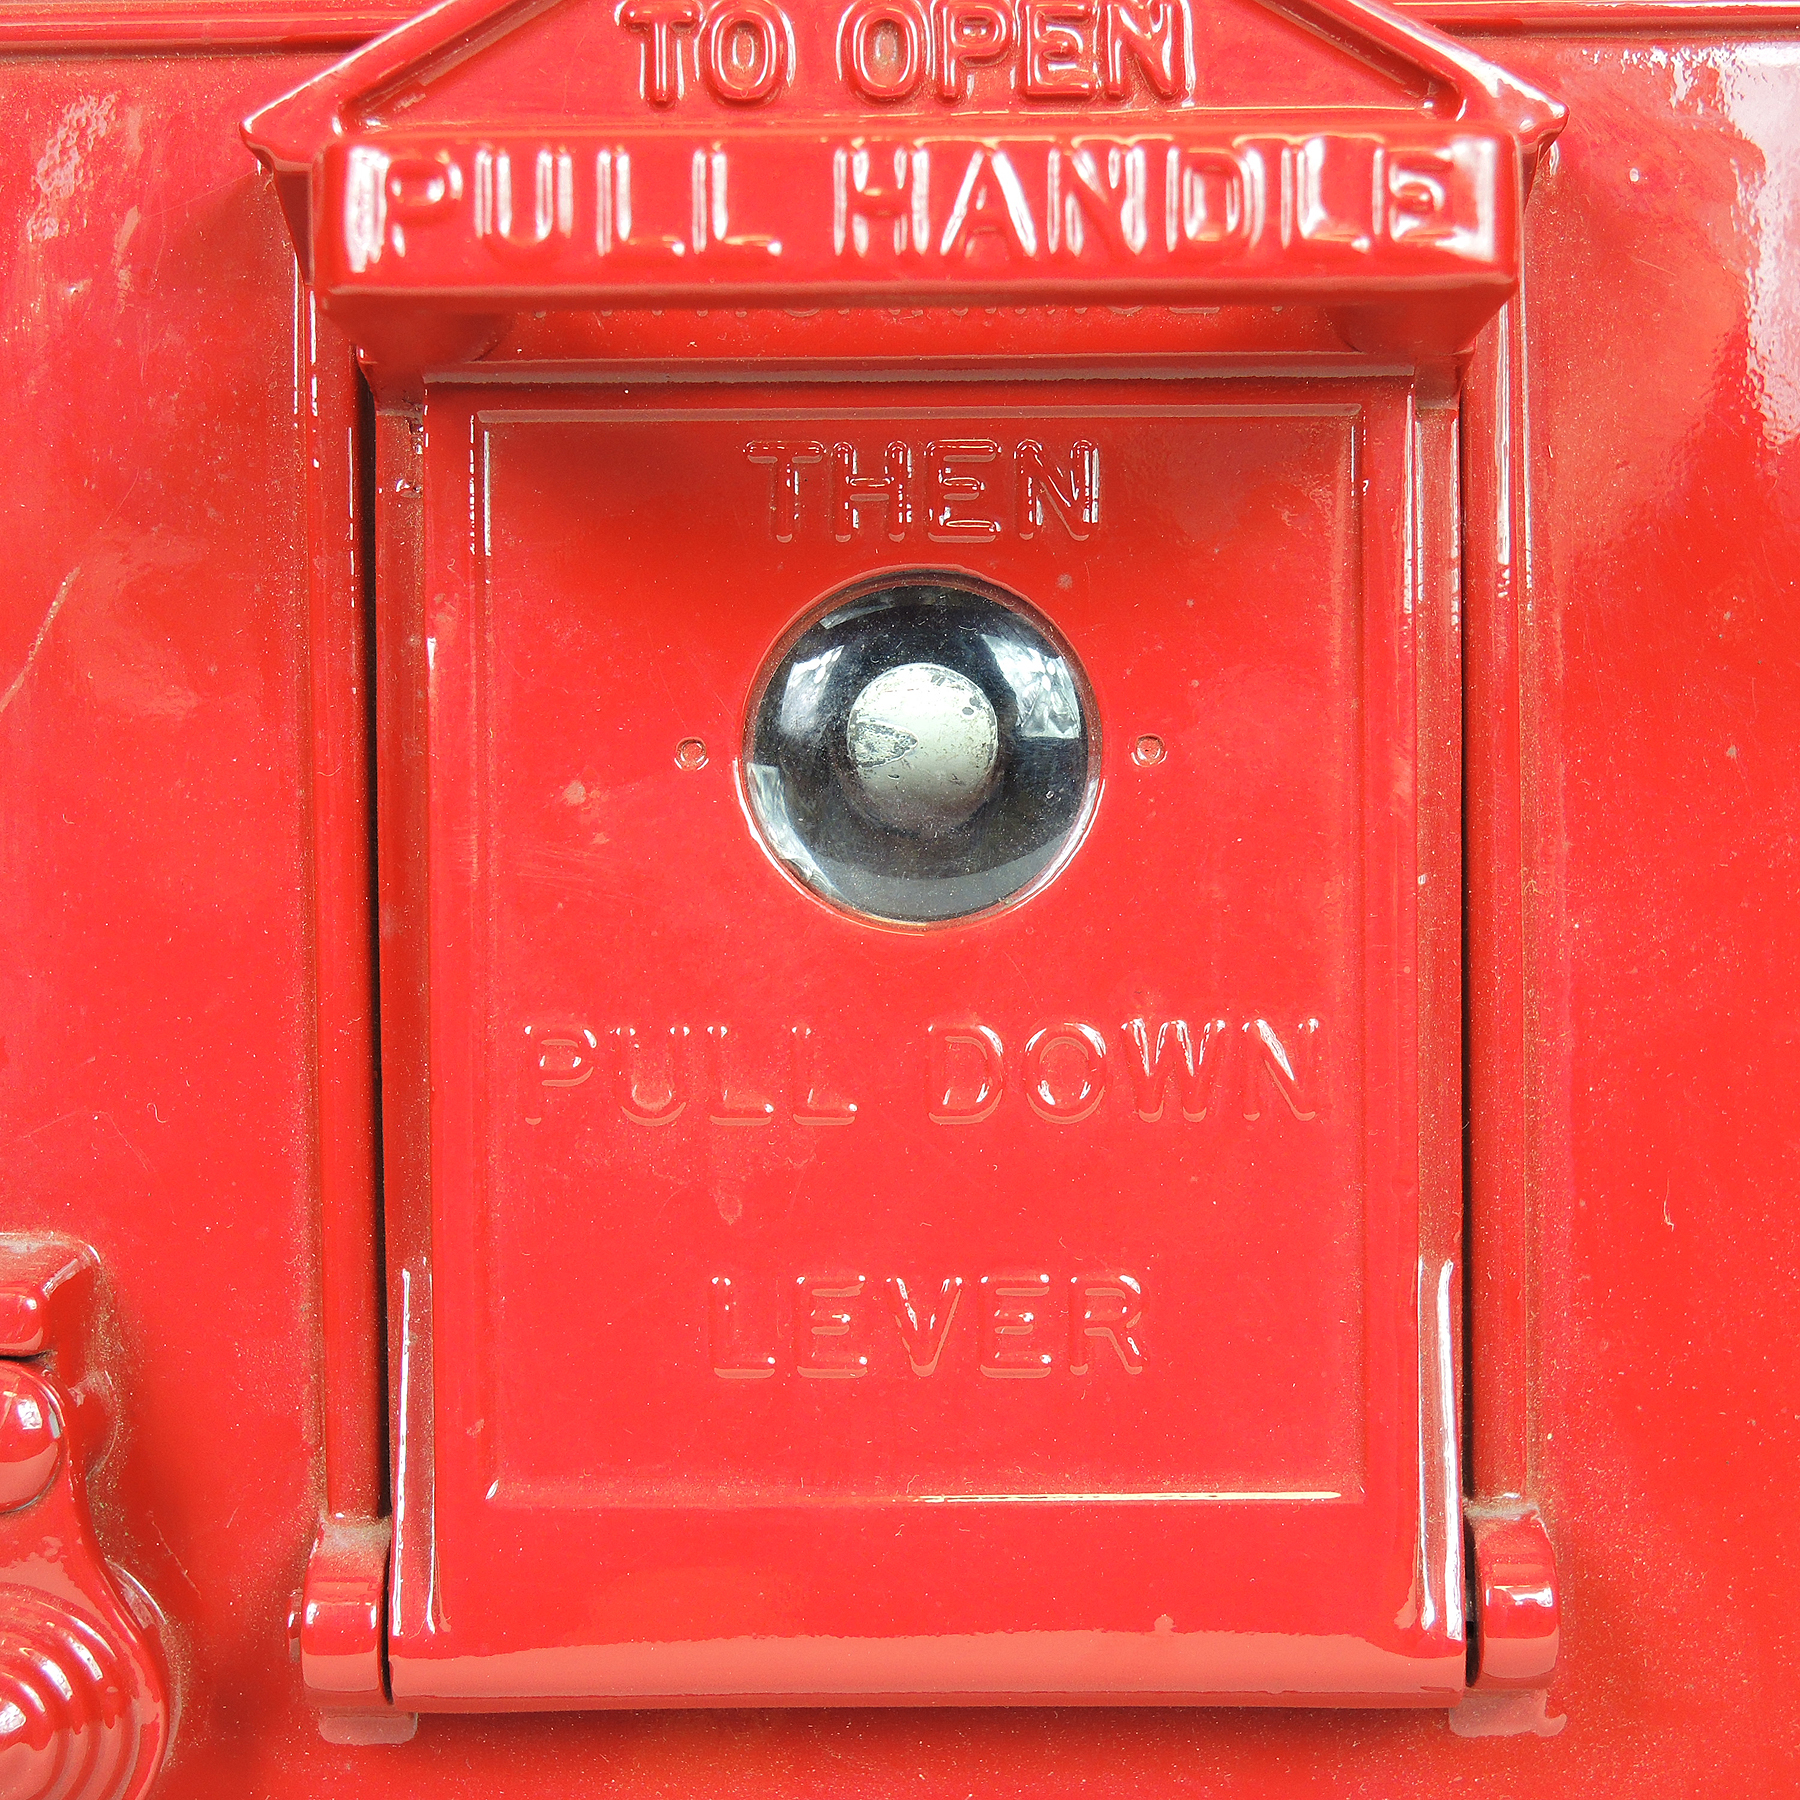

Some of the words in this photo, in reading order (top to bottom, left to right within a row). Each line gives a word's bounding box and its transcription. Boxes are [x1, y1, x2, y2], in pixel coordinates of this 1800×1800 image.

[615, 0, 792, 105] TO
[838, 0, 1194, 103] OPEN
[378, 145, 784, 258] PULL
[832, 145, 1462, 258] HANDLE
[744, 438, 1102, 542] THEN
[522, 1023, 859, 1126] PULL
[922, 1018, 1322, 1124] DOWN
[710, 1274, 1147, 1379] LEVER
